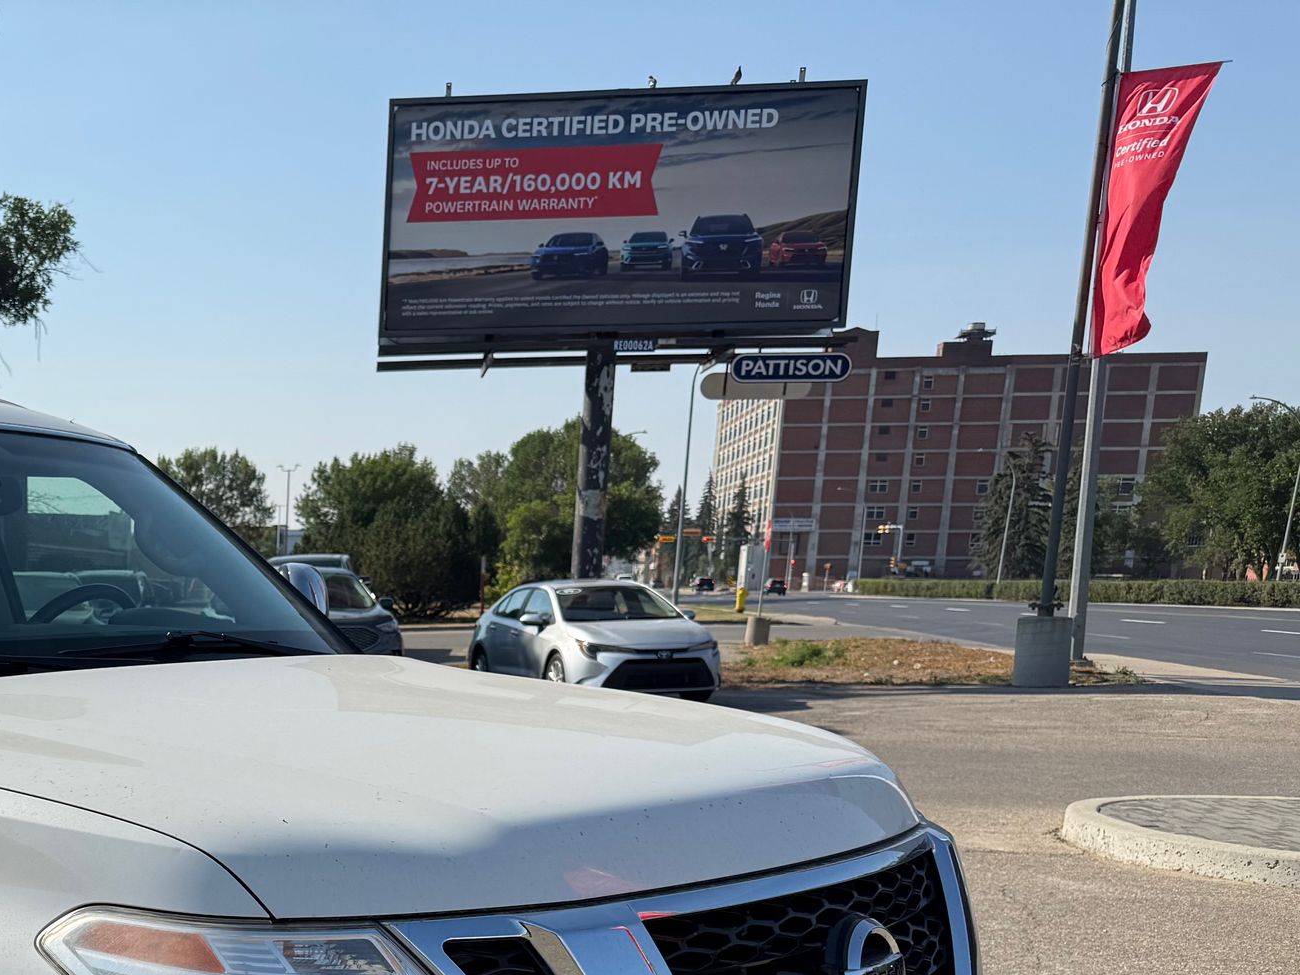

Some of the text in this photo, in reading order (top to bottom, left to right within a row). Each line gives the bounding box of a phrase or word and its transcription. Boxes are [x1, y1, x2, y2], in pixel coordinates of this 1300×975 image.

[411, 108, 779, 142] HONDA CERTIFIED PRE-OWNED
[1117, 117, 1179, 134] HONDA
[1116, 138, 1169, 157] Certified
[426, 157, 520, 171] INCLUDES UP TO
[425, 170, 642, 195] 7-YEAR/160,000 KM
[424, 200, 514, 214] POWERTRAIN
[755, 292, 781, 300] Regina
[741, 359, 842, 375] PATTISON
